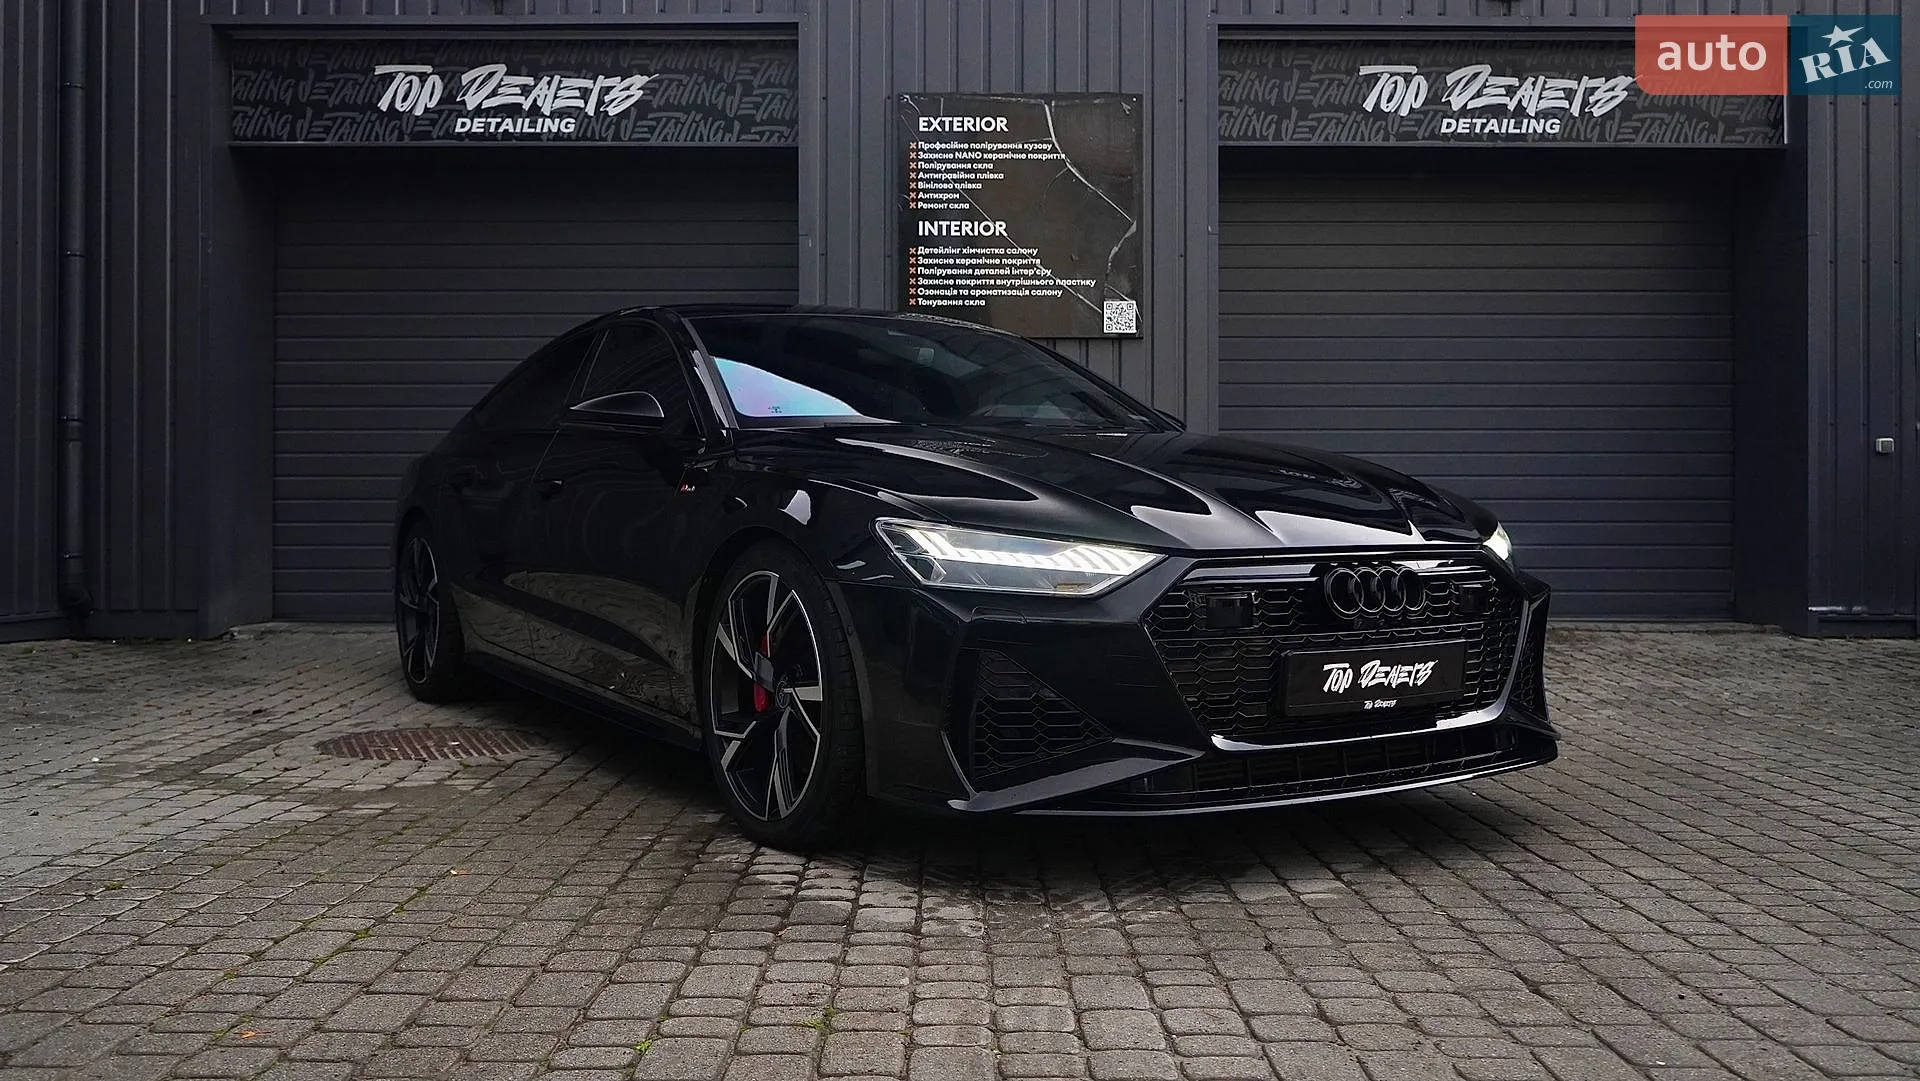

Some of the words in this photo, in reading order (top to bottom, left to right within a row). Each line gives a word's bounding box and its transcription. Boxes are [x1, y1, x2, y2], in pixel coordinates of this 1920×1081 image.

[454, 117, 577, 134] DETAILING
[918, 117, 1008, 132] EXTERIOR
[1440, 117, 1562, 134] DETAILING
[955, 152, 982, 160] NANO
[918, 221, 1008, 237] INTERIOR
